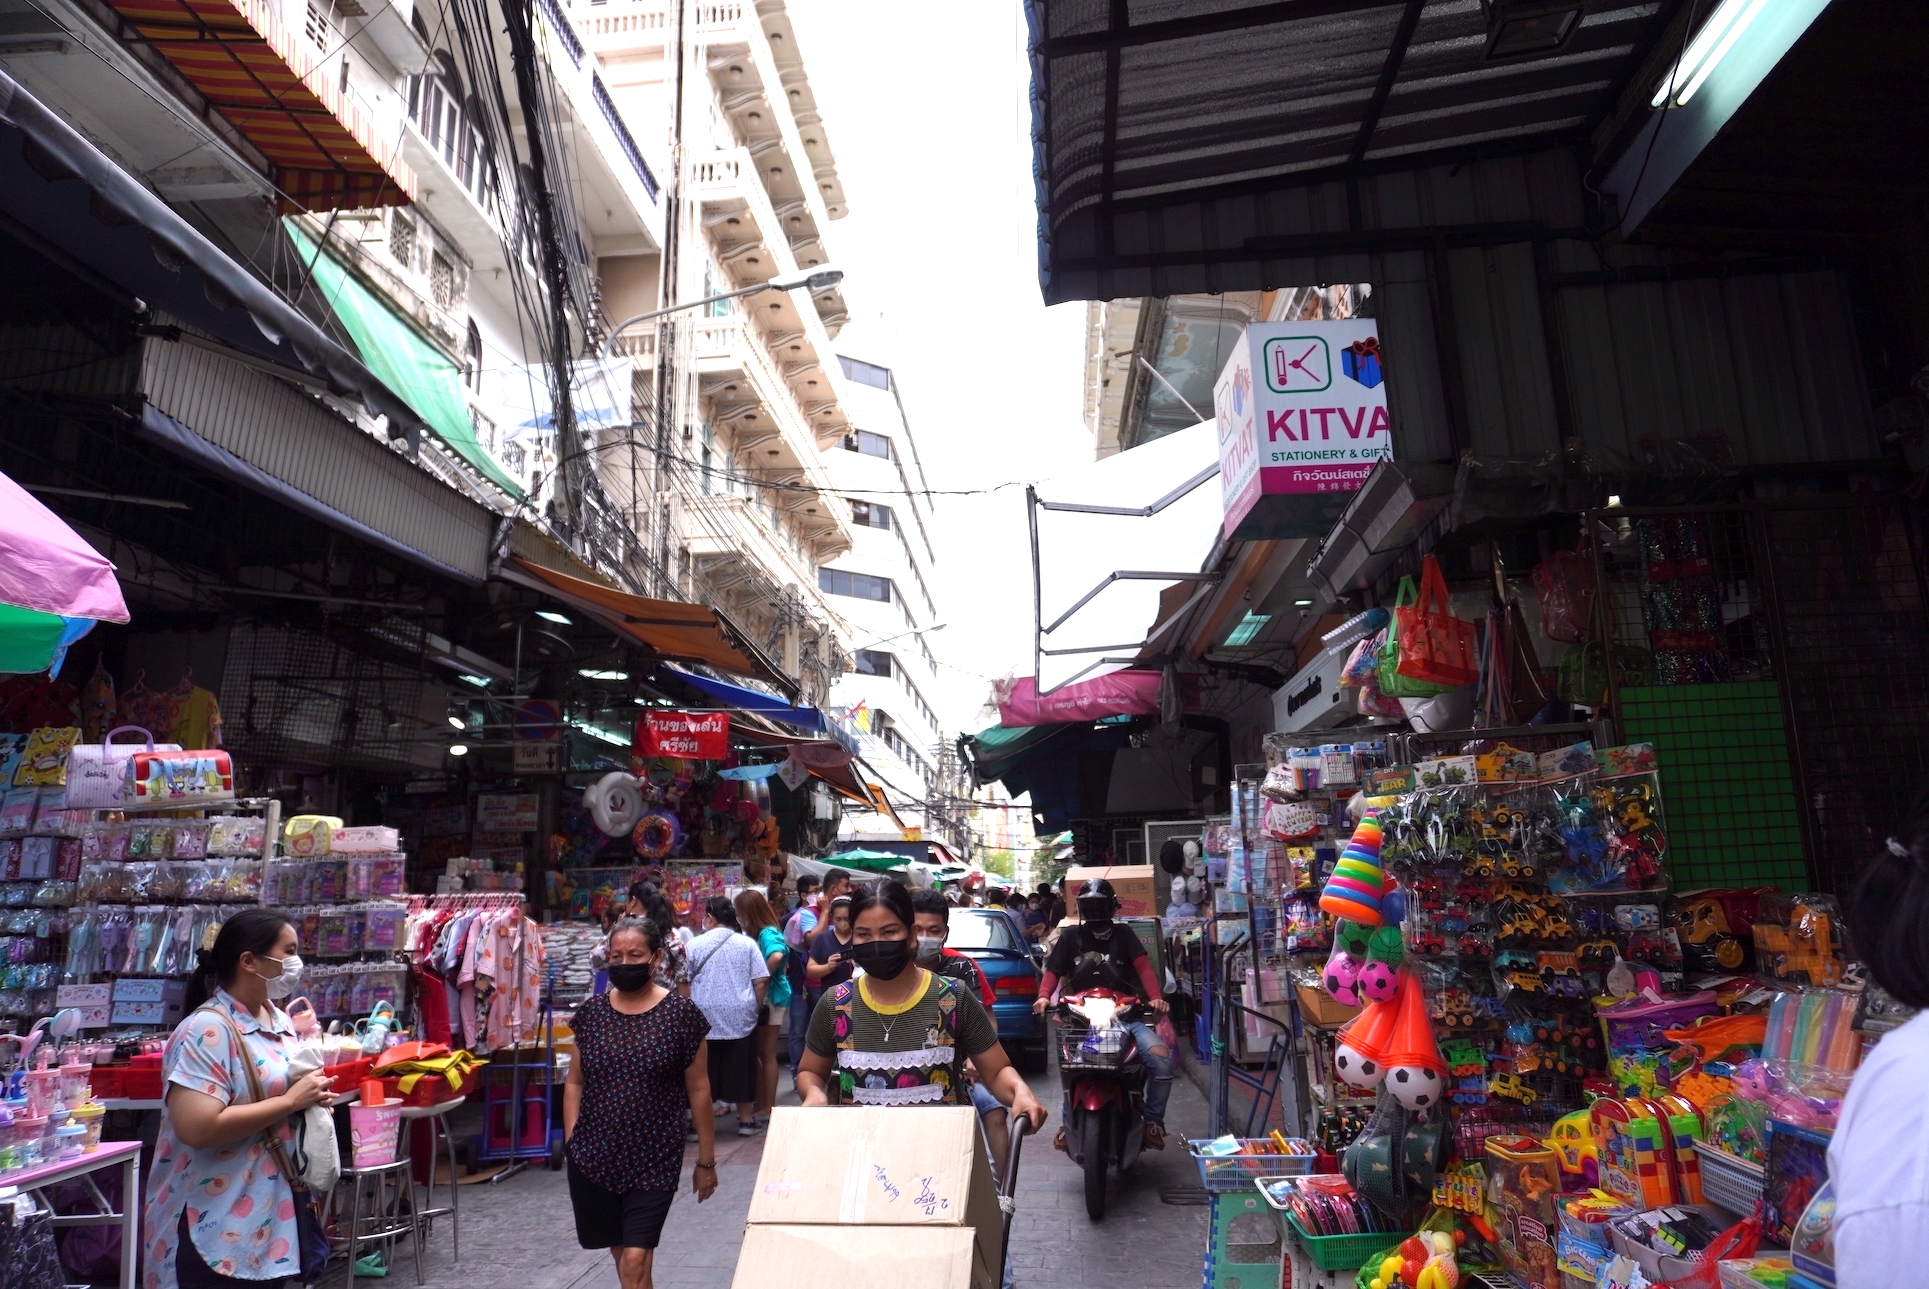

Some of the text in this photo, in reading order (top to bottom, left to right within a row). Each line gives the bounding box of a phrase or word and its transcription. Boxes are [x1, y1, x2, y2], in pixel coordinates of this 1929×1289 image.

[1222, 417, 1253, 492] KITVAT
[1271, 450, 1346, 462] STATIONERY
[1350, 449, 1358, 458] &
[644, 712, 722, 733] ร้านของเล่น
[660, 737, 698, 753] ศรีชัย
[1381, 778, 1407, 790] CAR
[1282, 819, 1297, 830] NEW
[1296, 815, 1313, 824] YEAR
[1286, 811, 1306, 821] HAPPY
[1520, 1224, 1544, 1238] education
[1521, 1219, 1543, 1232] creative
[1564, 1244, 1578, 1255] BIG
[1578, 1248, 1596, 1266] CRAB
